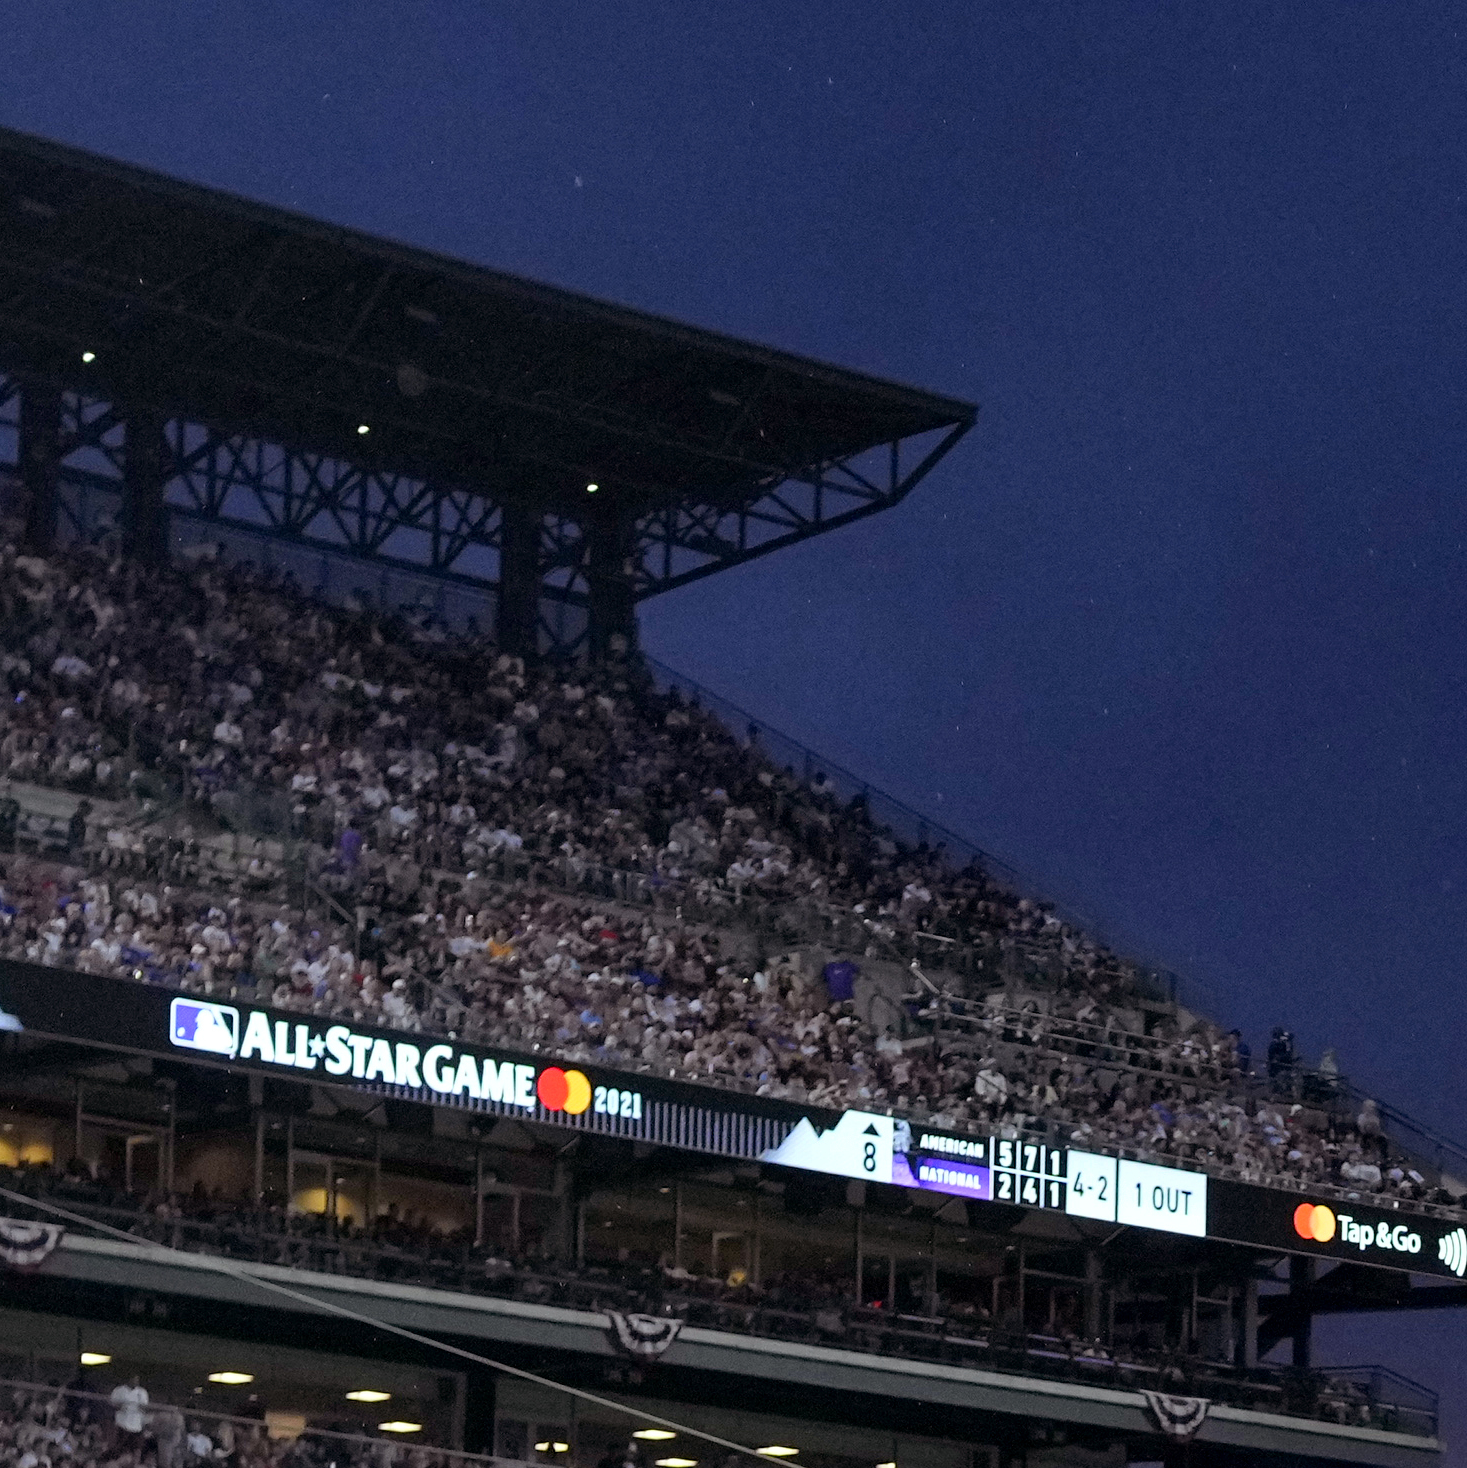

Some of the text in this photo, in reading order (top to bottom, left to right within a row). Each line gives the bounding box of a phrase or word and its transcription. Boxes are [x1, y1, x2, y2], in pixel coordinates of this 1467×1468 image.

[422, 1044, 536, 1109] GAME
[593, 1085, 642, 1120] 2021
[863, 1142, 877, 1173] 8
[920, 1133, 1060, 1176] AMERICAN 5 7 1
[919, 1165, 1060, 1207] NATIONAL 2 4 1
[1073, 1171, 1108, 1201] 4-2
[1135, 1182, 1193, 1216] 1 OUT
